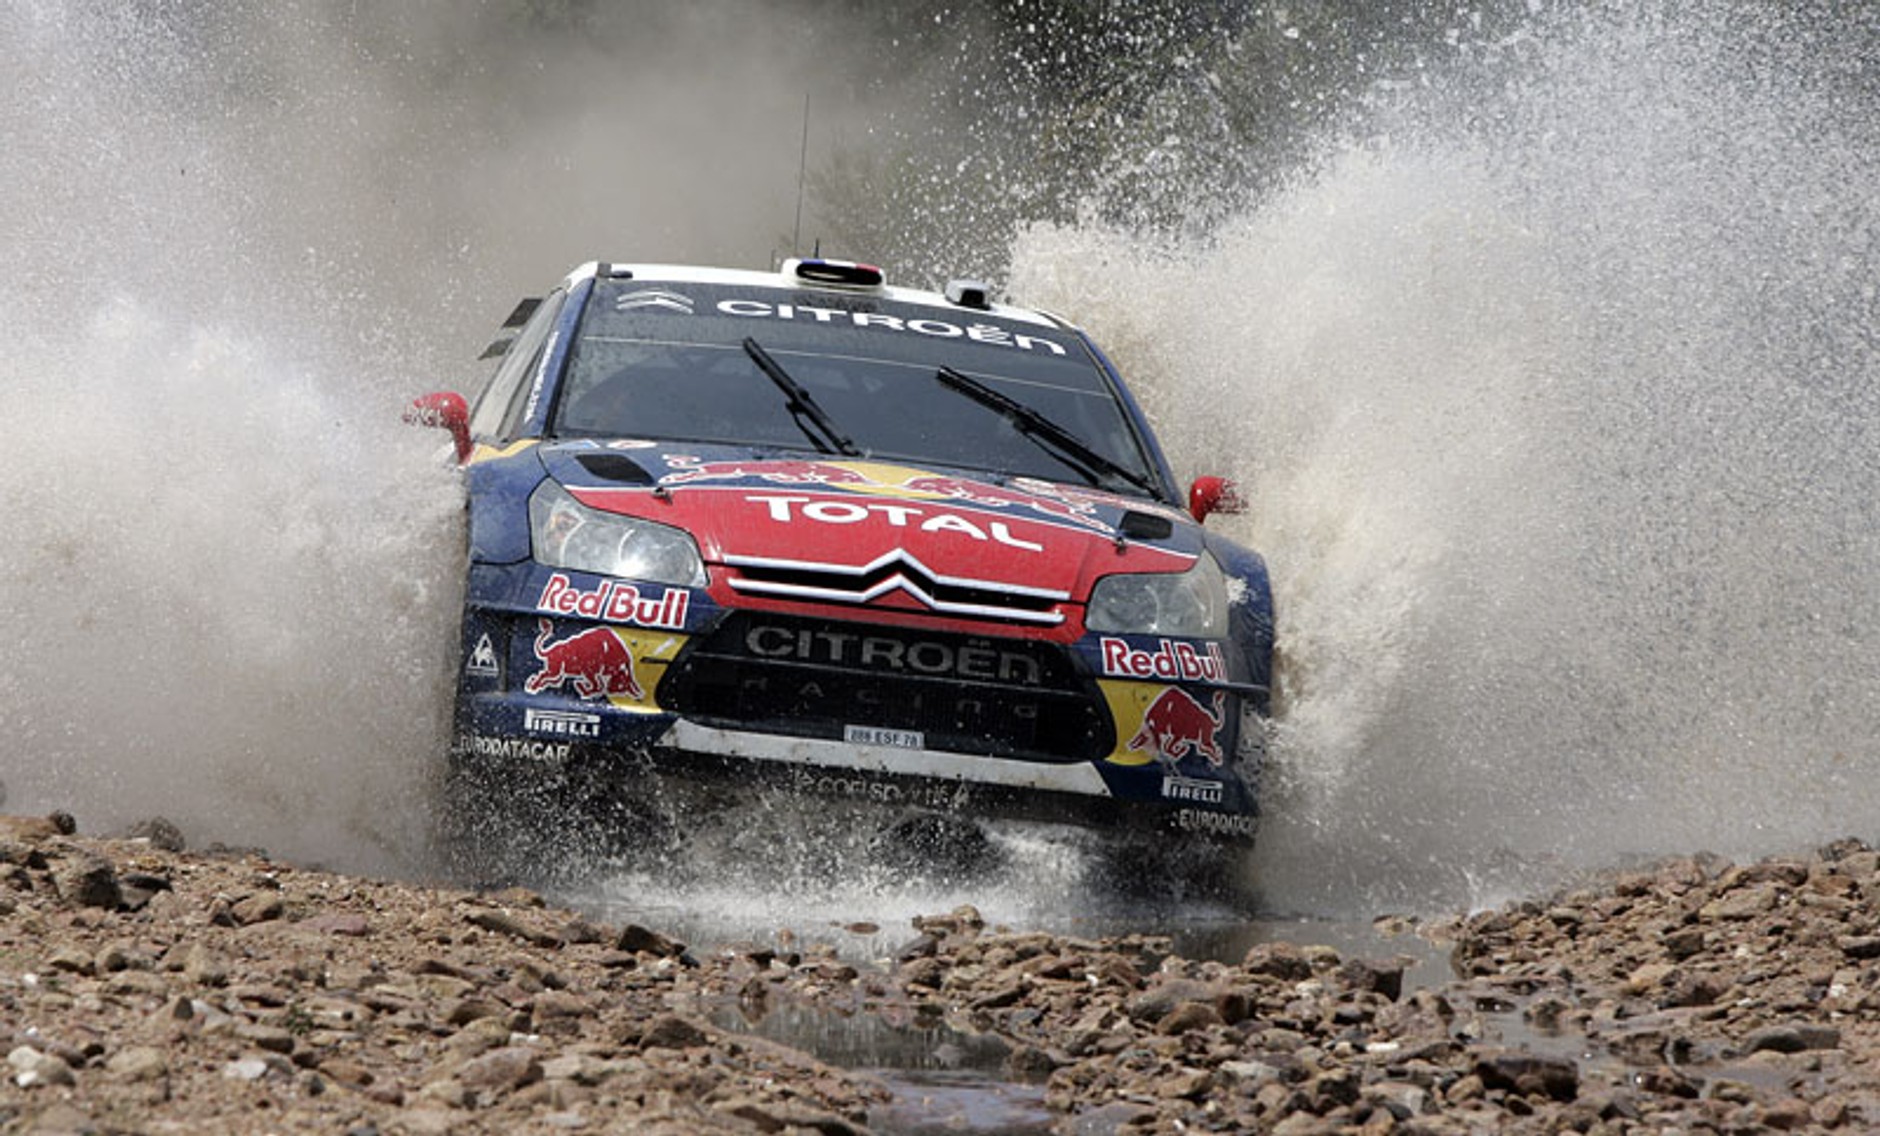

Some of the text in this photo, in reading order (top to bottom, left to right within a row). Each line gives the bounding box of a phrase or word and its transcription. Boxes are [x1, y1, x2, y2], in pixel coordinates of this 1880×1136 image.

[744, 495, 1043, 552] TOTAL
[536, 573, 690, 629] Red Bull
[1100, 636, 1228, 684] Red Bull
[524, 707, 601, 738] PIRELLI
[1161, 776, 1224, 803] PIRELLI
